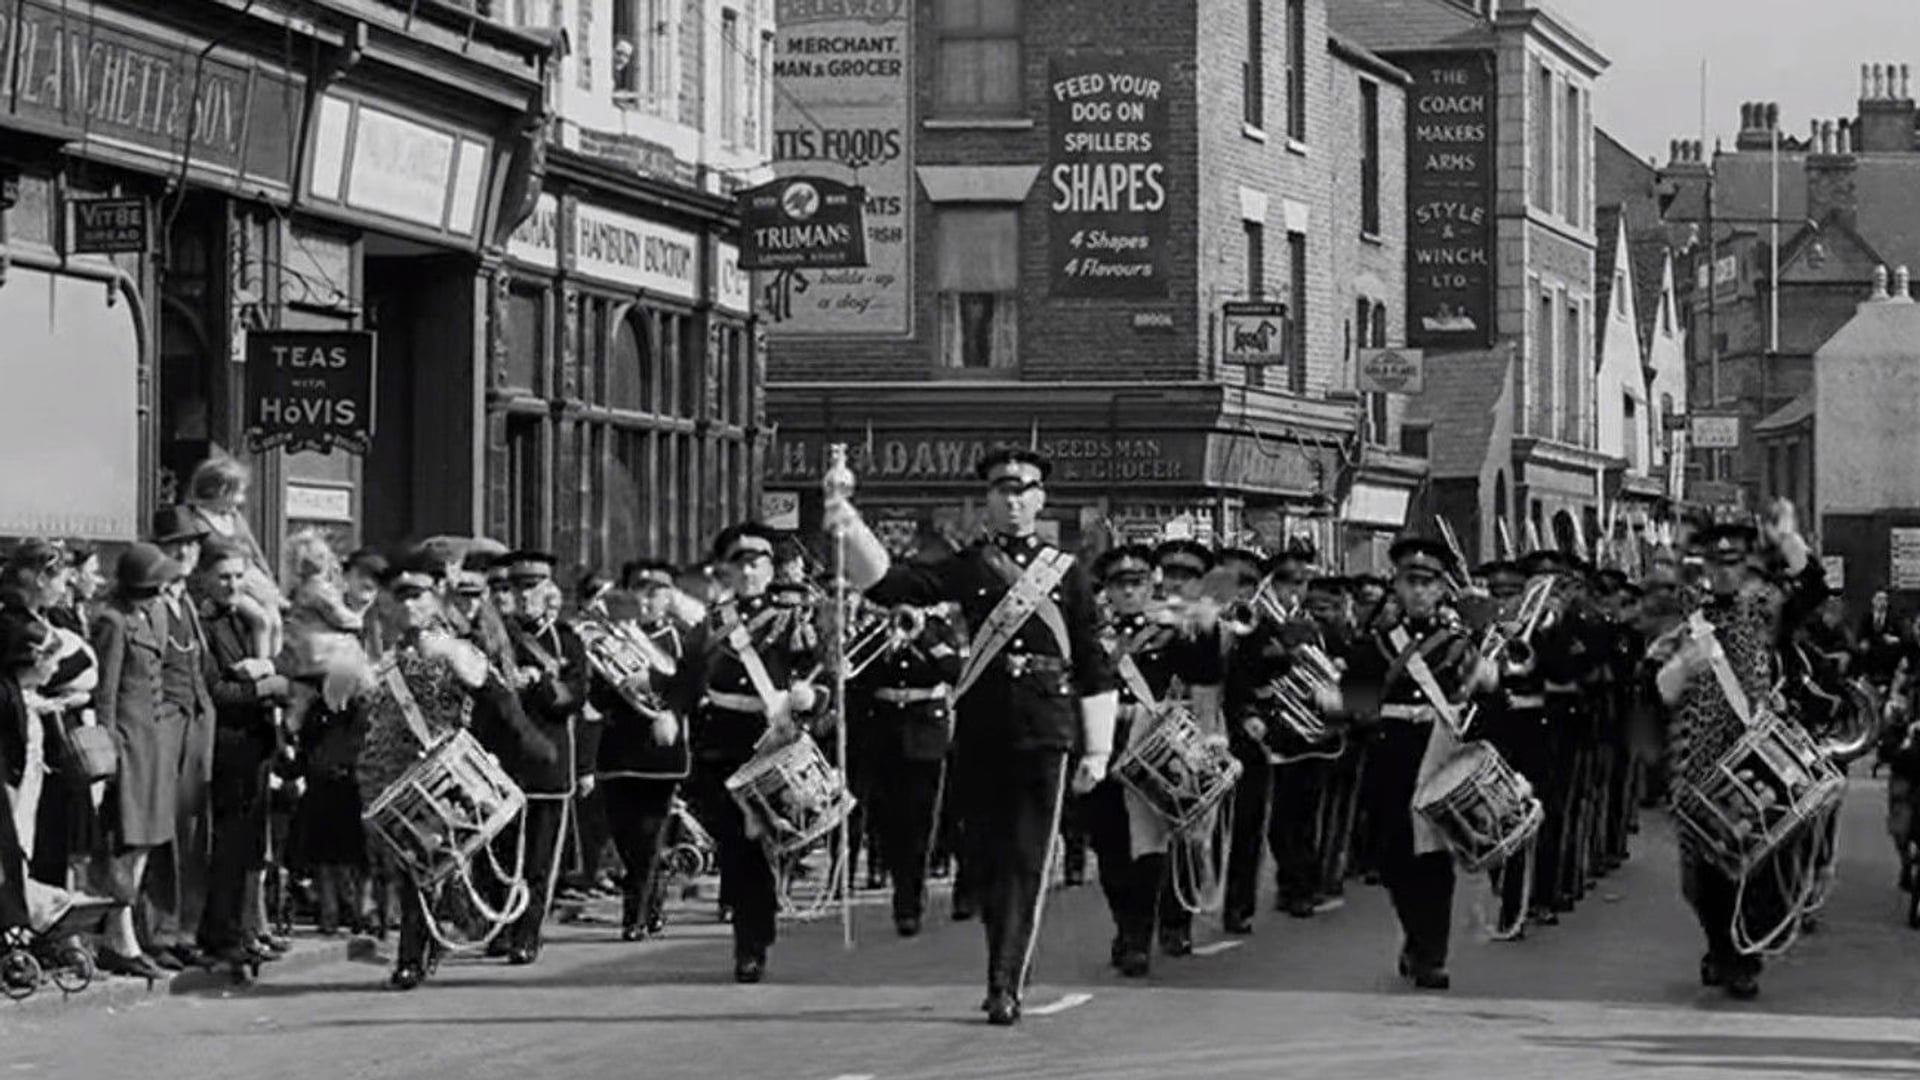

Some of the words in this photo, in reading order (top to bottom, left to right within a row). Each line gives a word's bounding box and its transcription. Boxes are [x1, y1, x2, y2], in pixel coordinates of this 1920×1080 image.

[774, 60, 811, 77] MAN
[828, 59, 902, 77] GROCER
[1431, 68, 1468, 84] THE
[1053, 73, 1104, 101] FEED
[1108, 73, 1160, 99] YOUR
[1072, 102, 1111, 121] DOG
[1117, 102, 1144, 121] ON
[1419, 96, 1484, 113] COACH
[1065, 132, 1152, 151] SPILLERS
[1418, 126, 1485, 141] MAKERS
[823, 129, 900, 160] FOODS
[1425, 154, 1475, 170] ARMS
[1052, 163, 1165, 211] SHAPES
[866, 196, 901, 215] ATS
[1416, 203, 1485, 224] STYLE
[1442, 224, 1454, 238] &
[1069, 230, 1085, 248] 4
[1086, 230, 1149, 252] Shapes
[1064, 258, 1079, 276] 4
[1080, 258, 1152, 277] Flavours
[271, 346, 347, 368] TEAS
[1043, 438, 1161, 458] SEEDSMAN
[1091, 459, 1181, 479] GROCER
